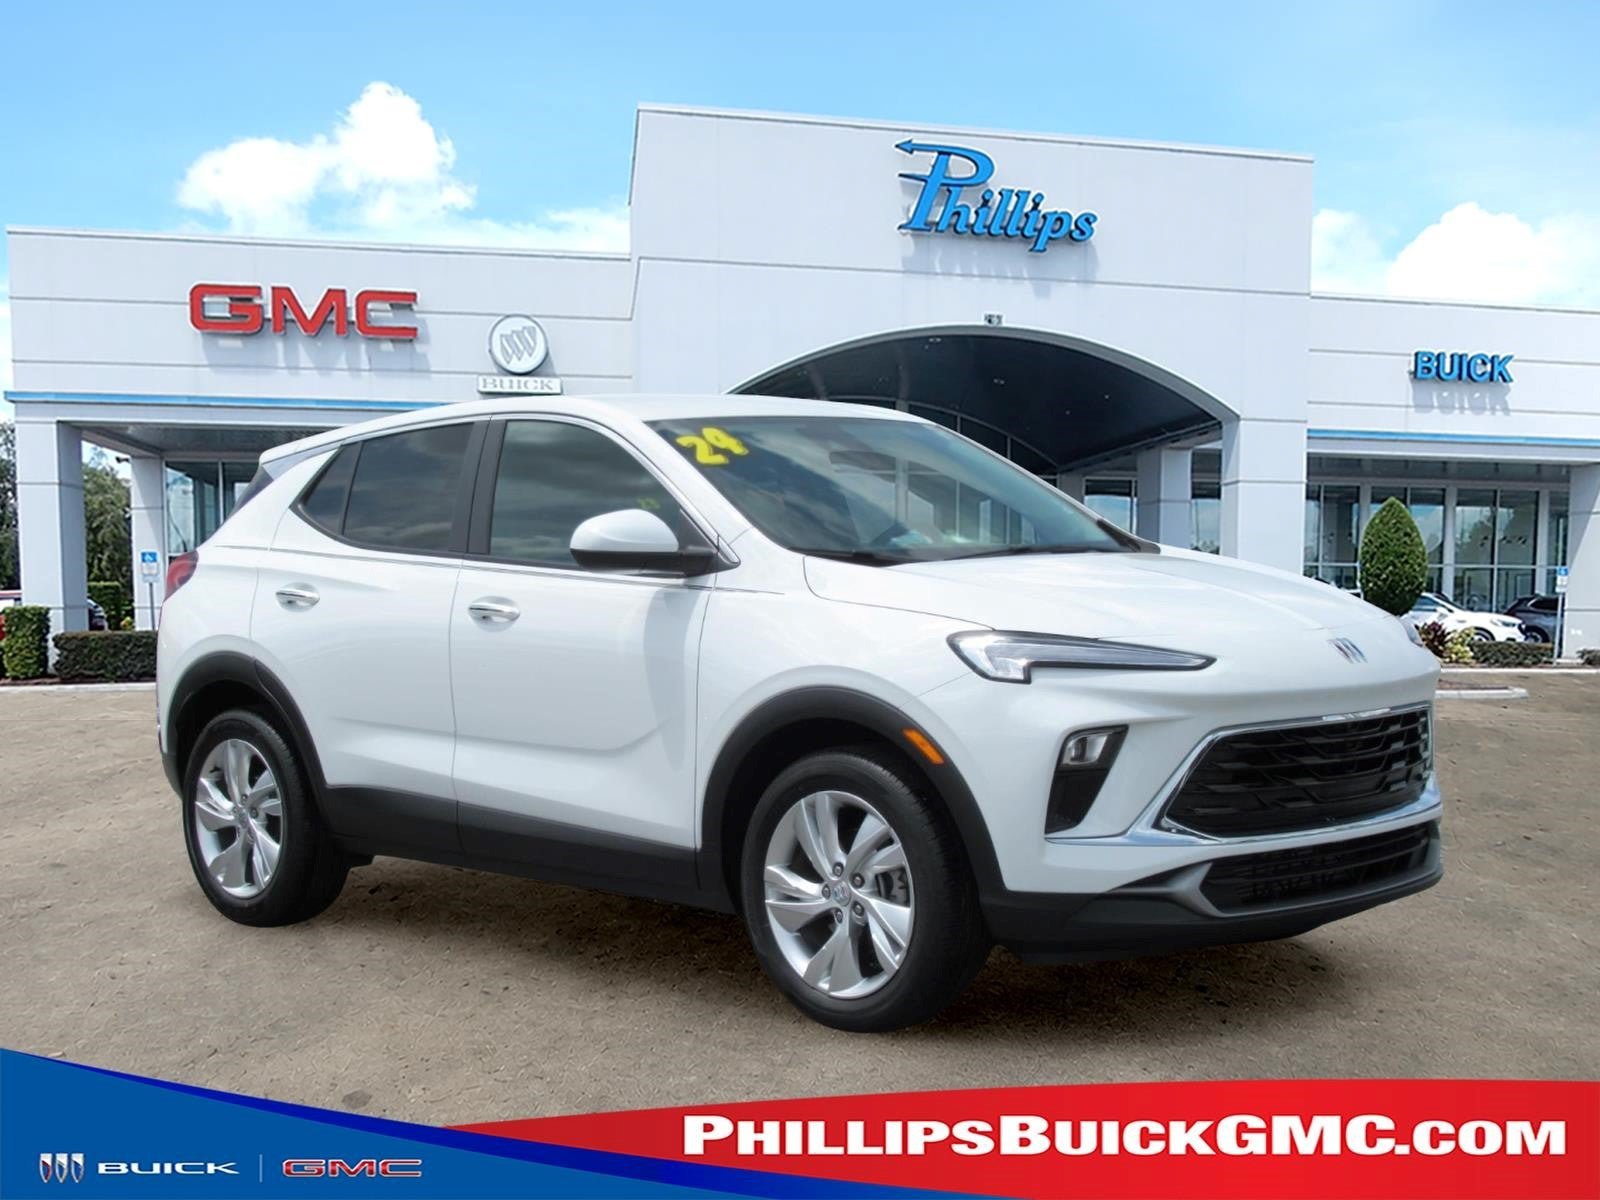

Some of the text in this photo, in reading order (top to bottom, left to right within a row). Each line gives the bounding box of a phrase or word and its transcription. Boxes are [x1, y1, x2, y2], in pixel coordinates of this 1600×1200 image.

[895, 139, 1098, 252] Phillips
[189, 283, 418, 340] GMC
[481, 378, 554, 391] BUICK
[1411, 350, 1514, 383] BUICK
